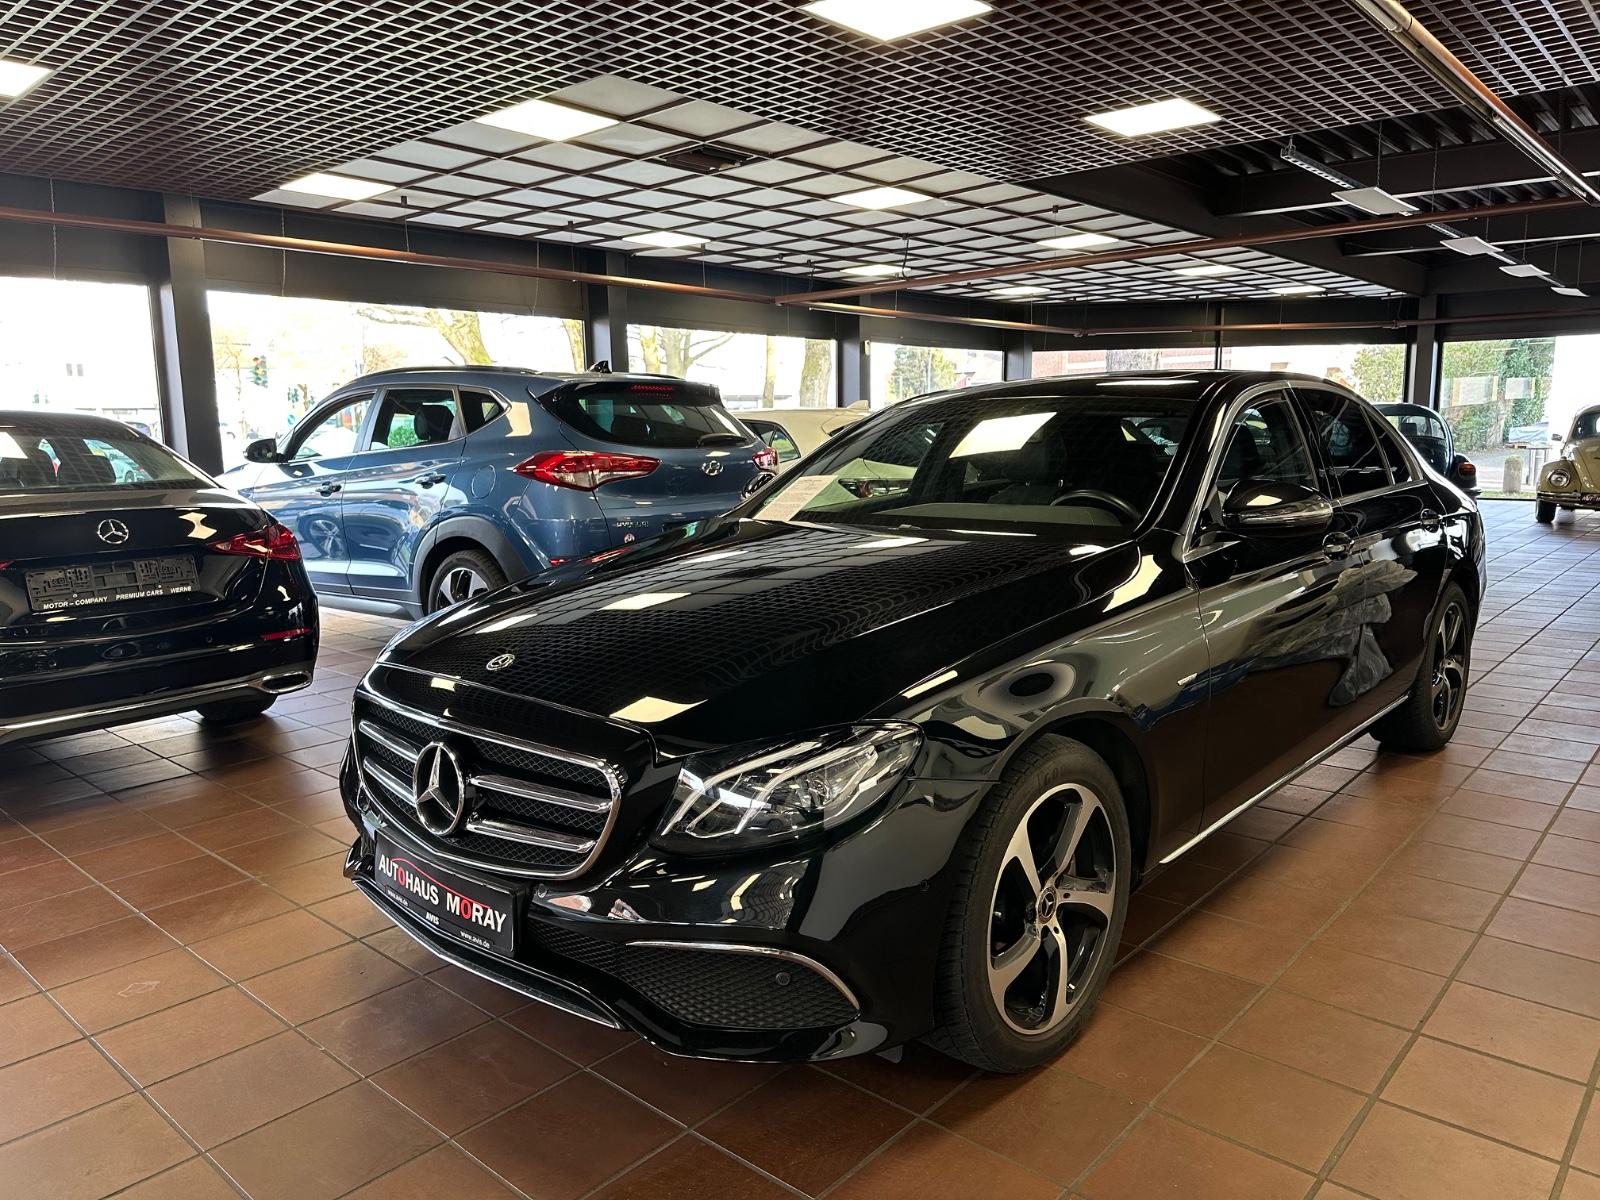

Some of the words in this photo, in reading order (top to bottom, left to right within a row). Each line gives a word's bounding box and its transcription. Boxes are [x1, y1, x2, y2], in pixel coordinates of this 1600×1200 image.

[43, 601, 69, 610] MOTOR
[74, 595, 108, 606] COMPANY
[115, 591, 145, 600] PREMIUM
[146, 589, 164, 597] CARS
[170, 586, 192, 594] WERNE
[378, 854, 440, 906] AUTOHAUS
[446, 892, 507, 933] MORAY
